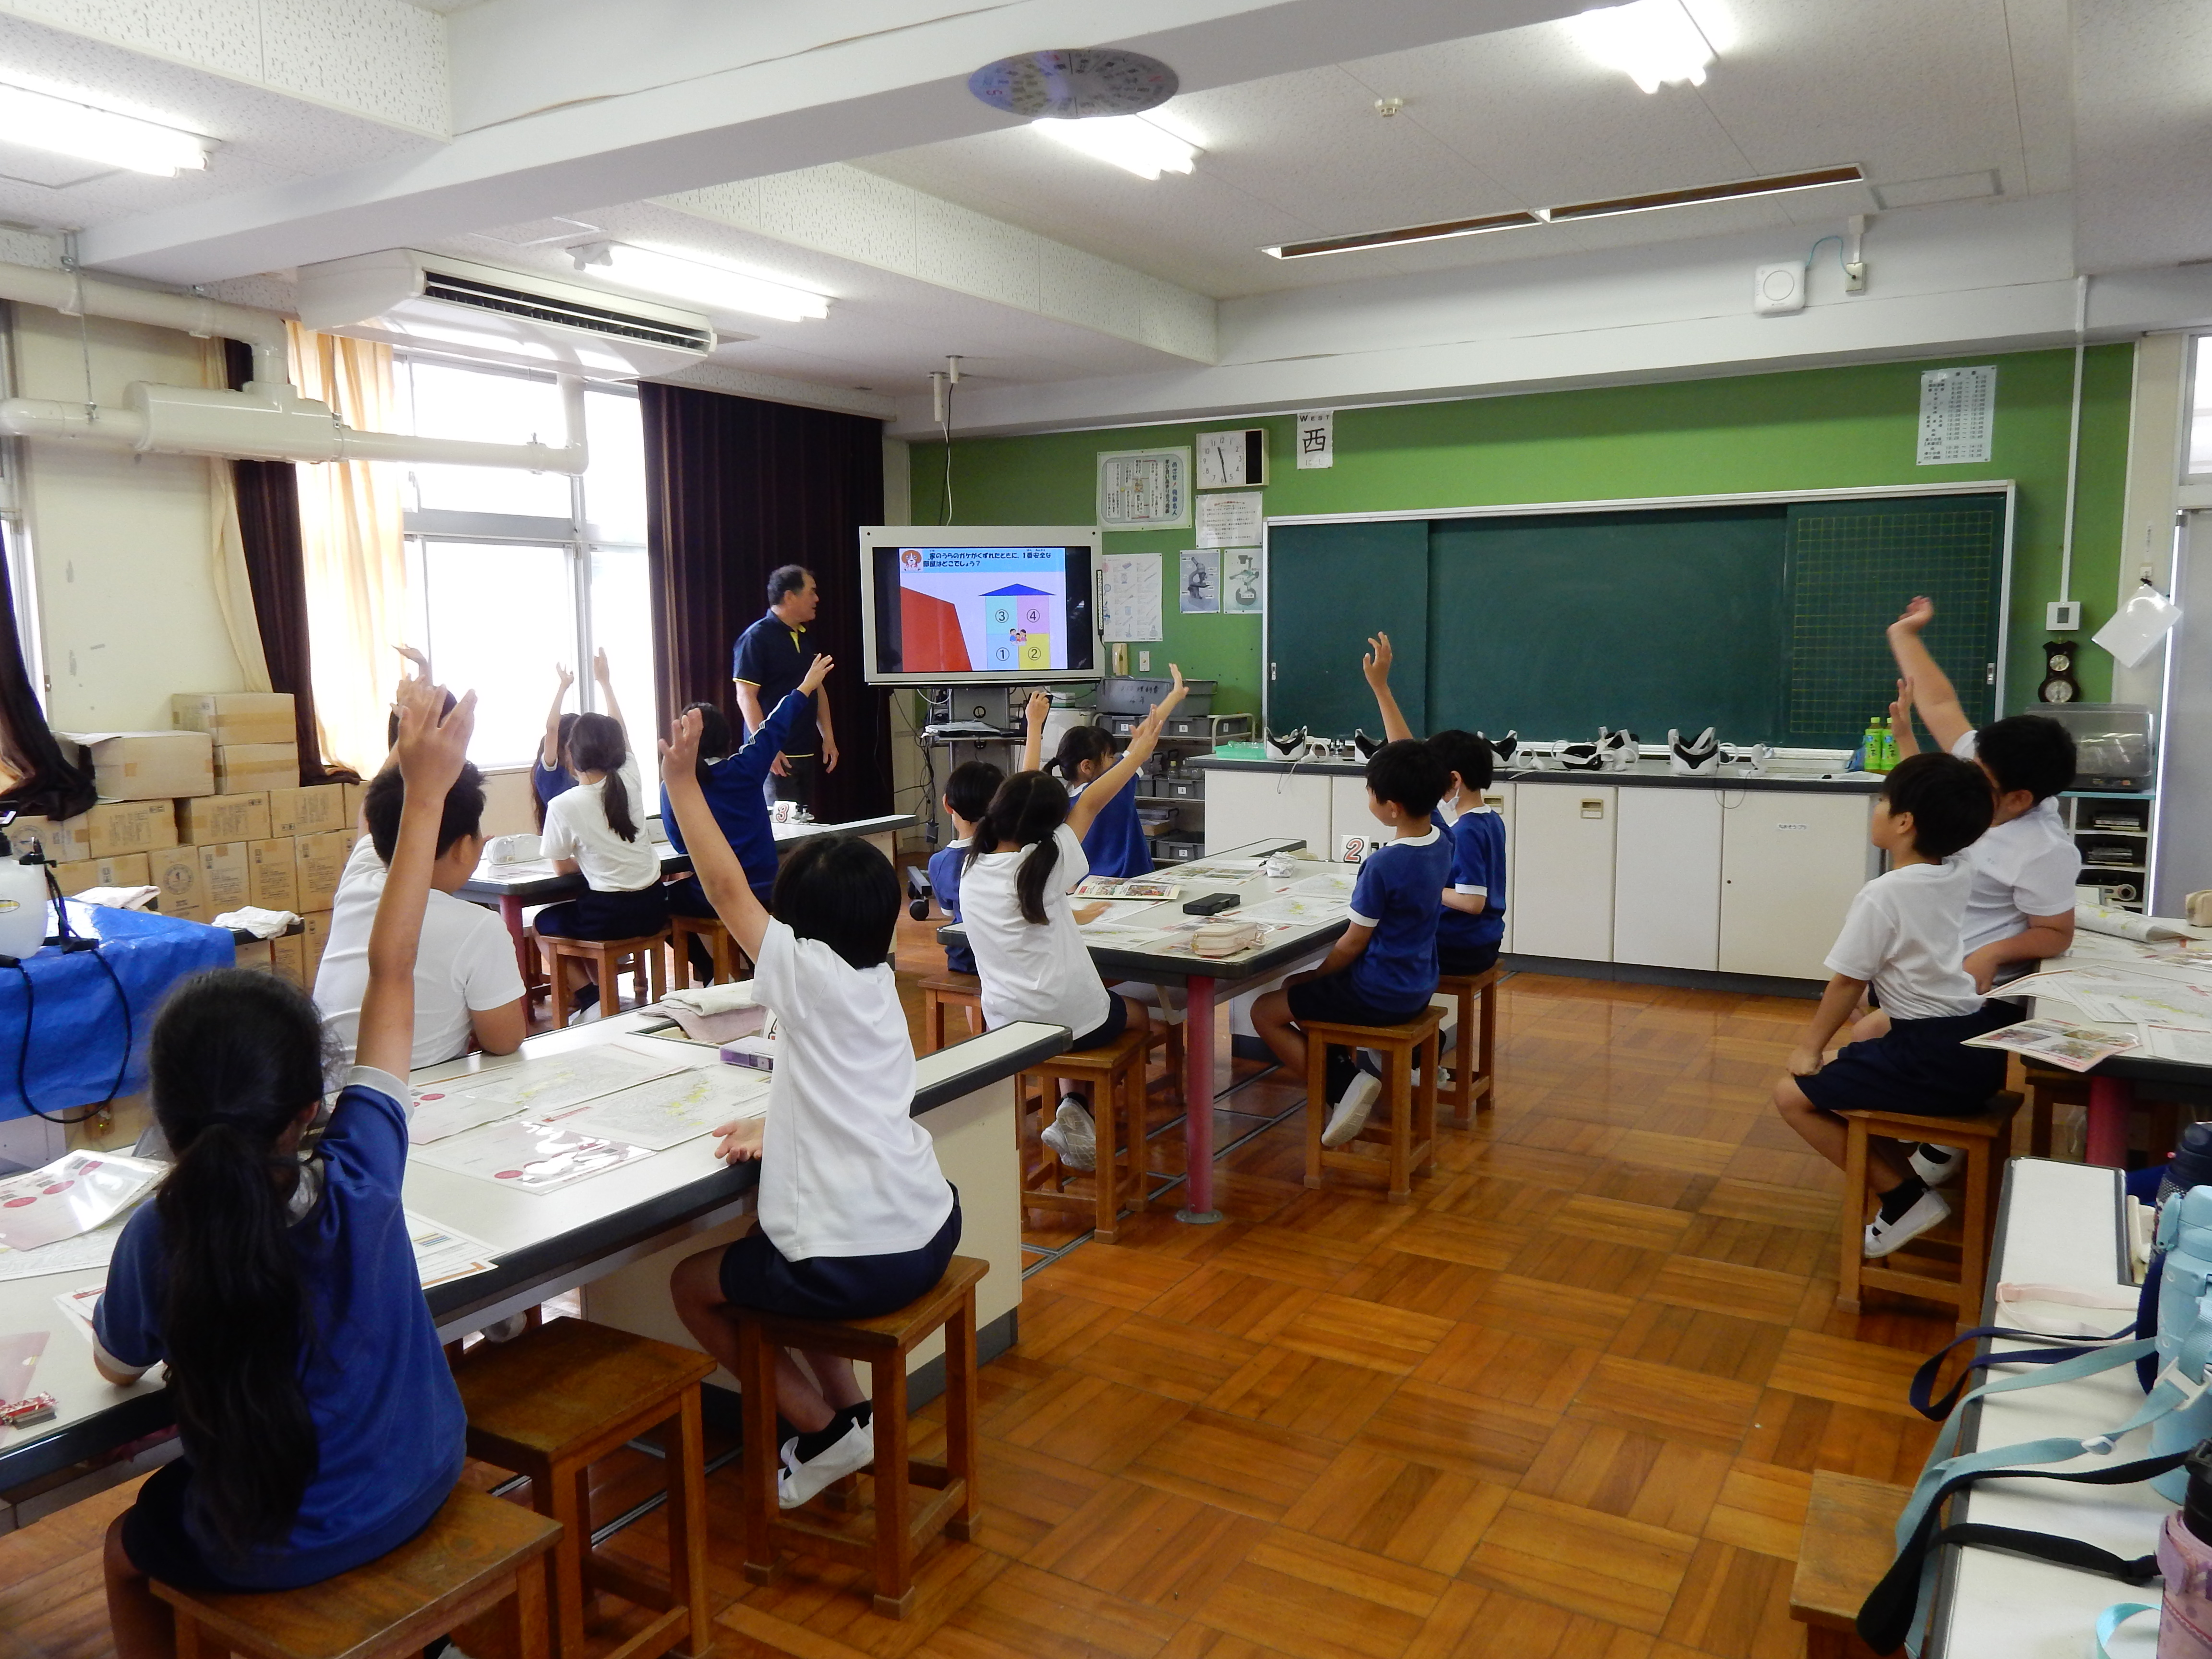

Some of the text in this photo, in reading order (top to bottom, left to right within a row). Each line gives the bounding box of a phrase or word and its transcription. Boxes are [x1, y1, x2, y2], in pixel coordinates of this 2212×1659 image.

[1302, 428, 1326, 454] 西
[776, 803, 790, 823] 3
[1343, 838, 1365, 863] 2
